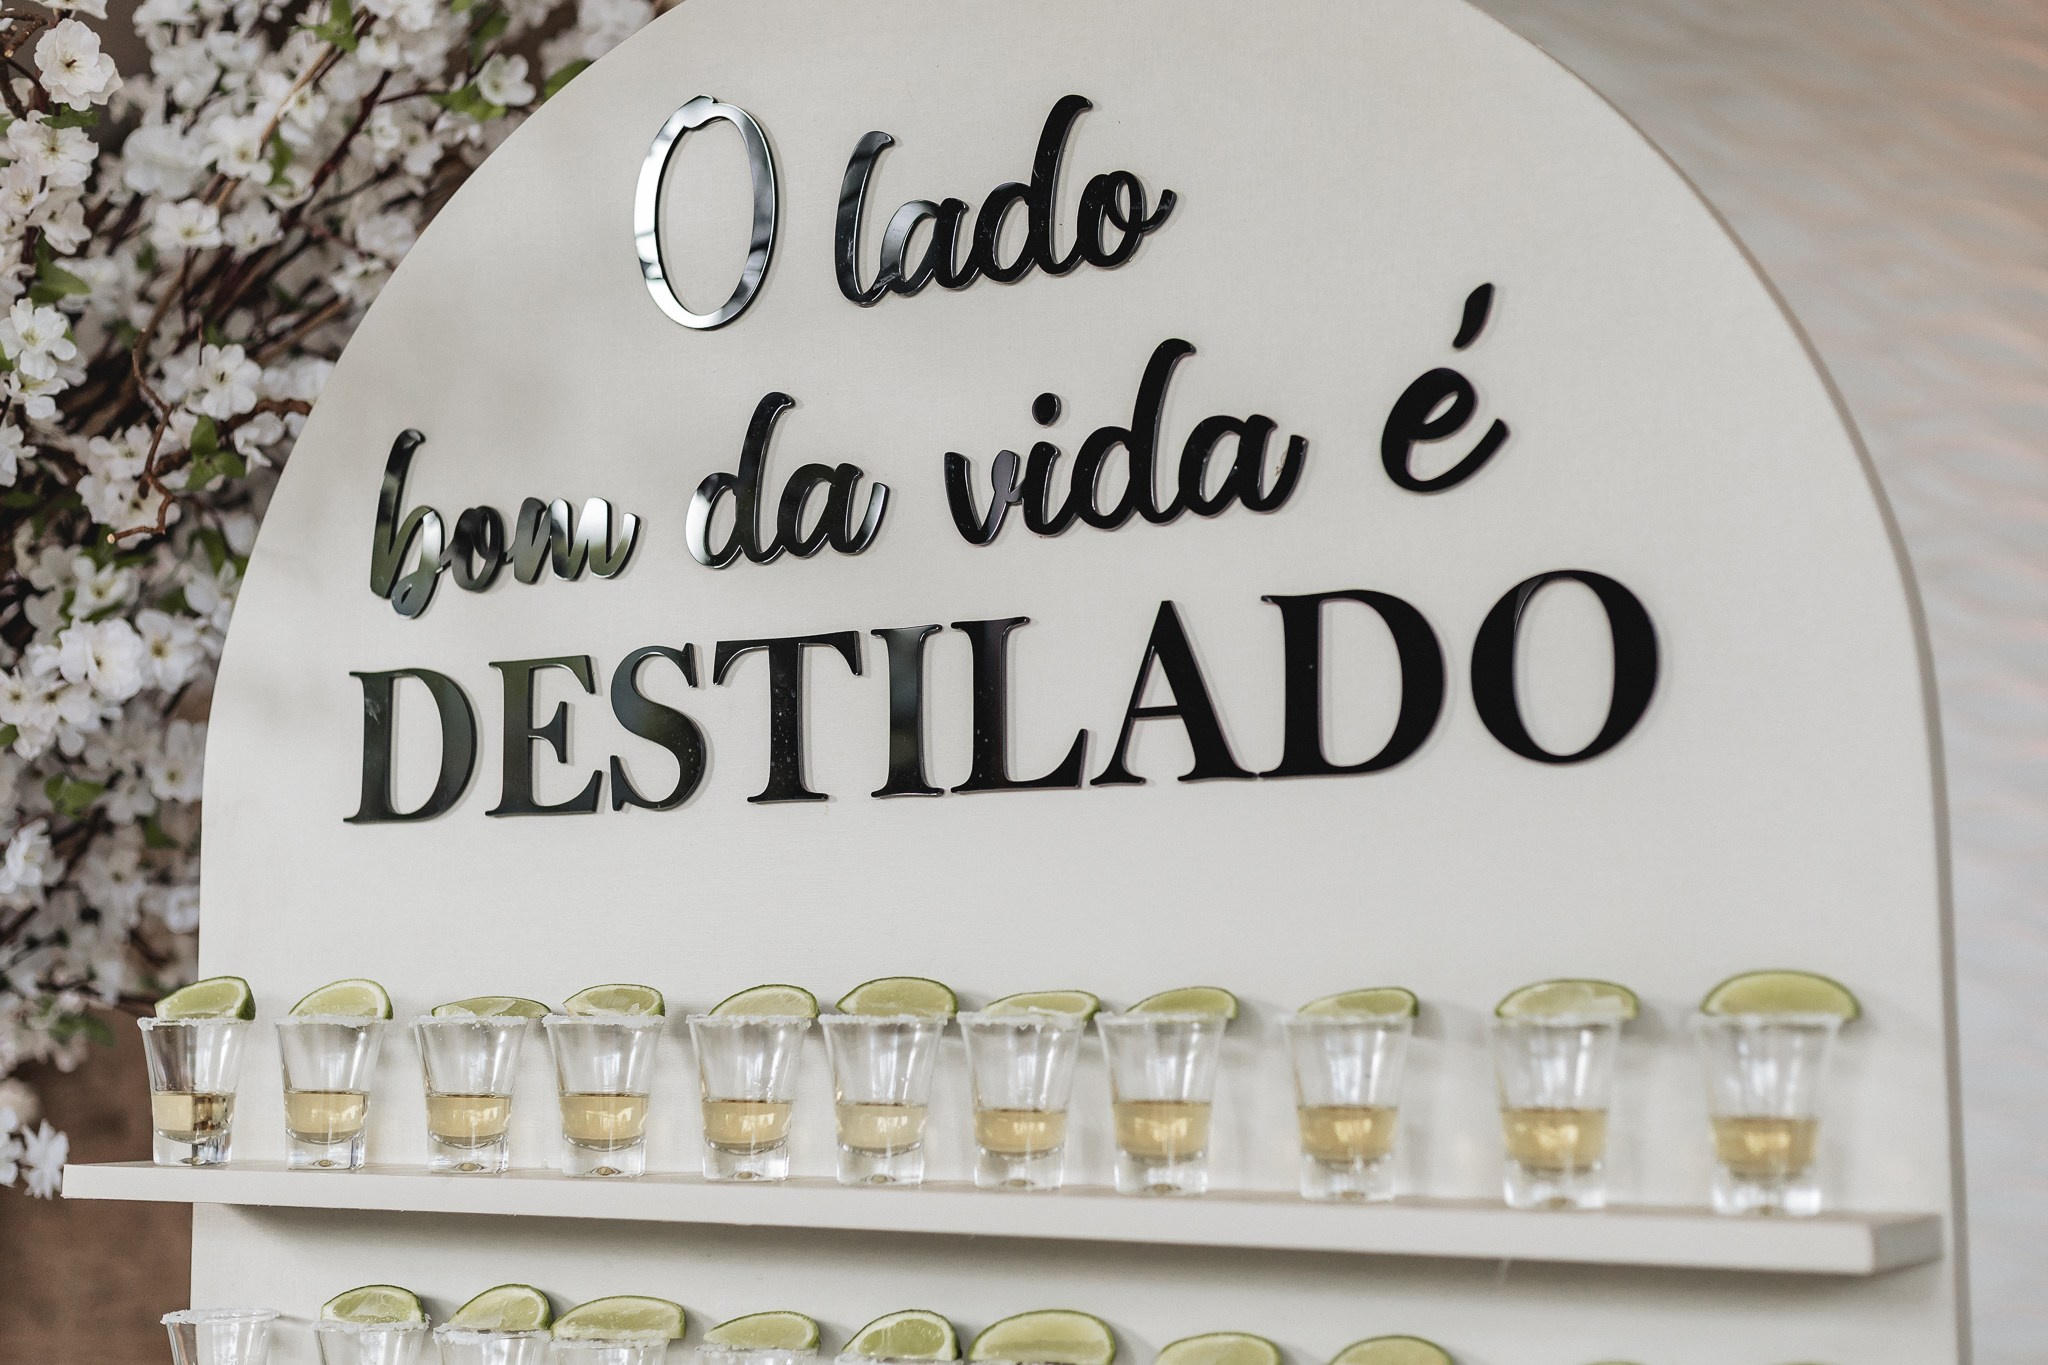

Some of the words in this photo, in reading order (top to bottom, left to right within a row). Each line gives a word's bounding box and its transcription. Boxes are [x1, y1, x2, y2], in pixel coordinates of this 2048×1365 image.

[633, 94, 779, 331] O
[834, 94, 1177, 308] lado
[369, 428, 641, 620] bom
[685, 391, 890, 570] da
[943, 338, 1310, 547] vida
[1381, 282, 1511, 496] é
[342, 569, 1660, 825] DESTILADO
